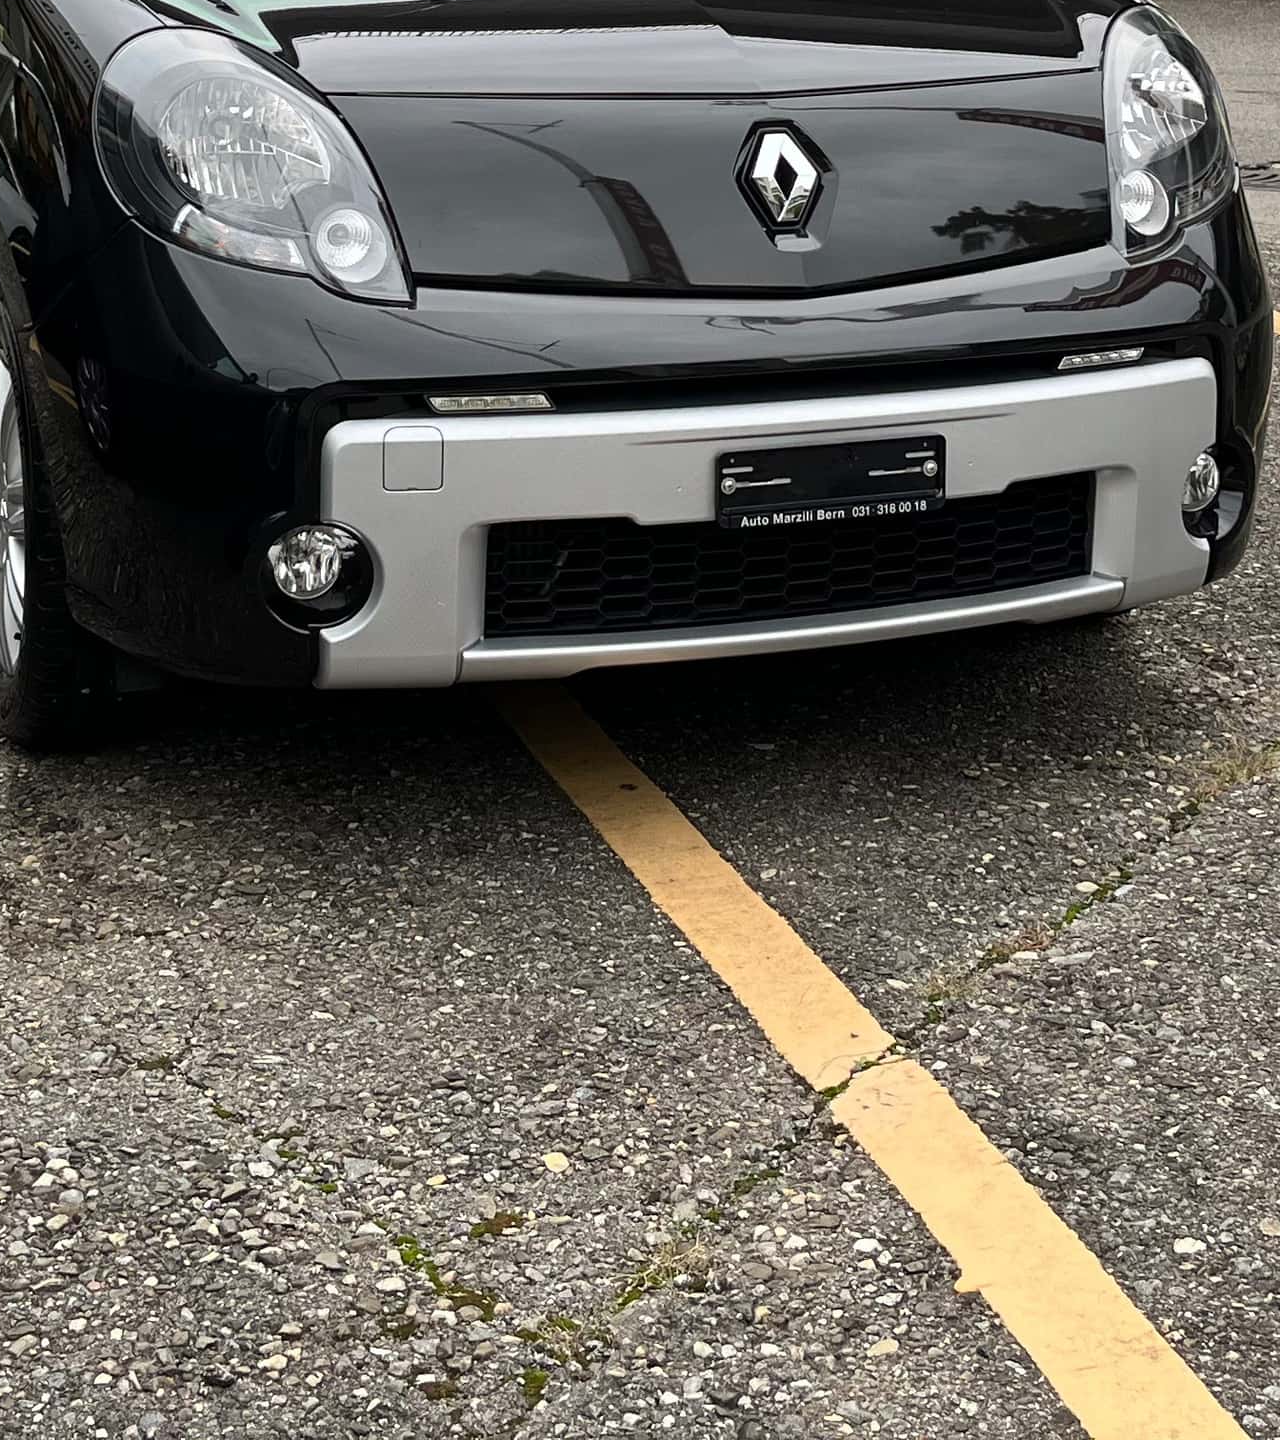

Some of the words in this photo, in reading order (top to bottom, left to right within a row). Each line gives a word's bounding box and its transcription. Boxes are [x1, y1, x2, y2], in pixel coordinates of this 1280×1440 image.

[740, 516, 769, 527] Auto
[773, 510, 813, 525] Marzili
[817, 509, 845, 521] Bern
[877, 503, 896, 515] 318
[898, 501, 912, 513] 00
[915, 500, 927, 511] 18
